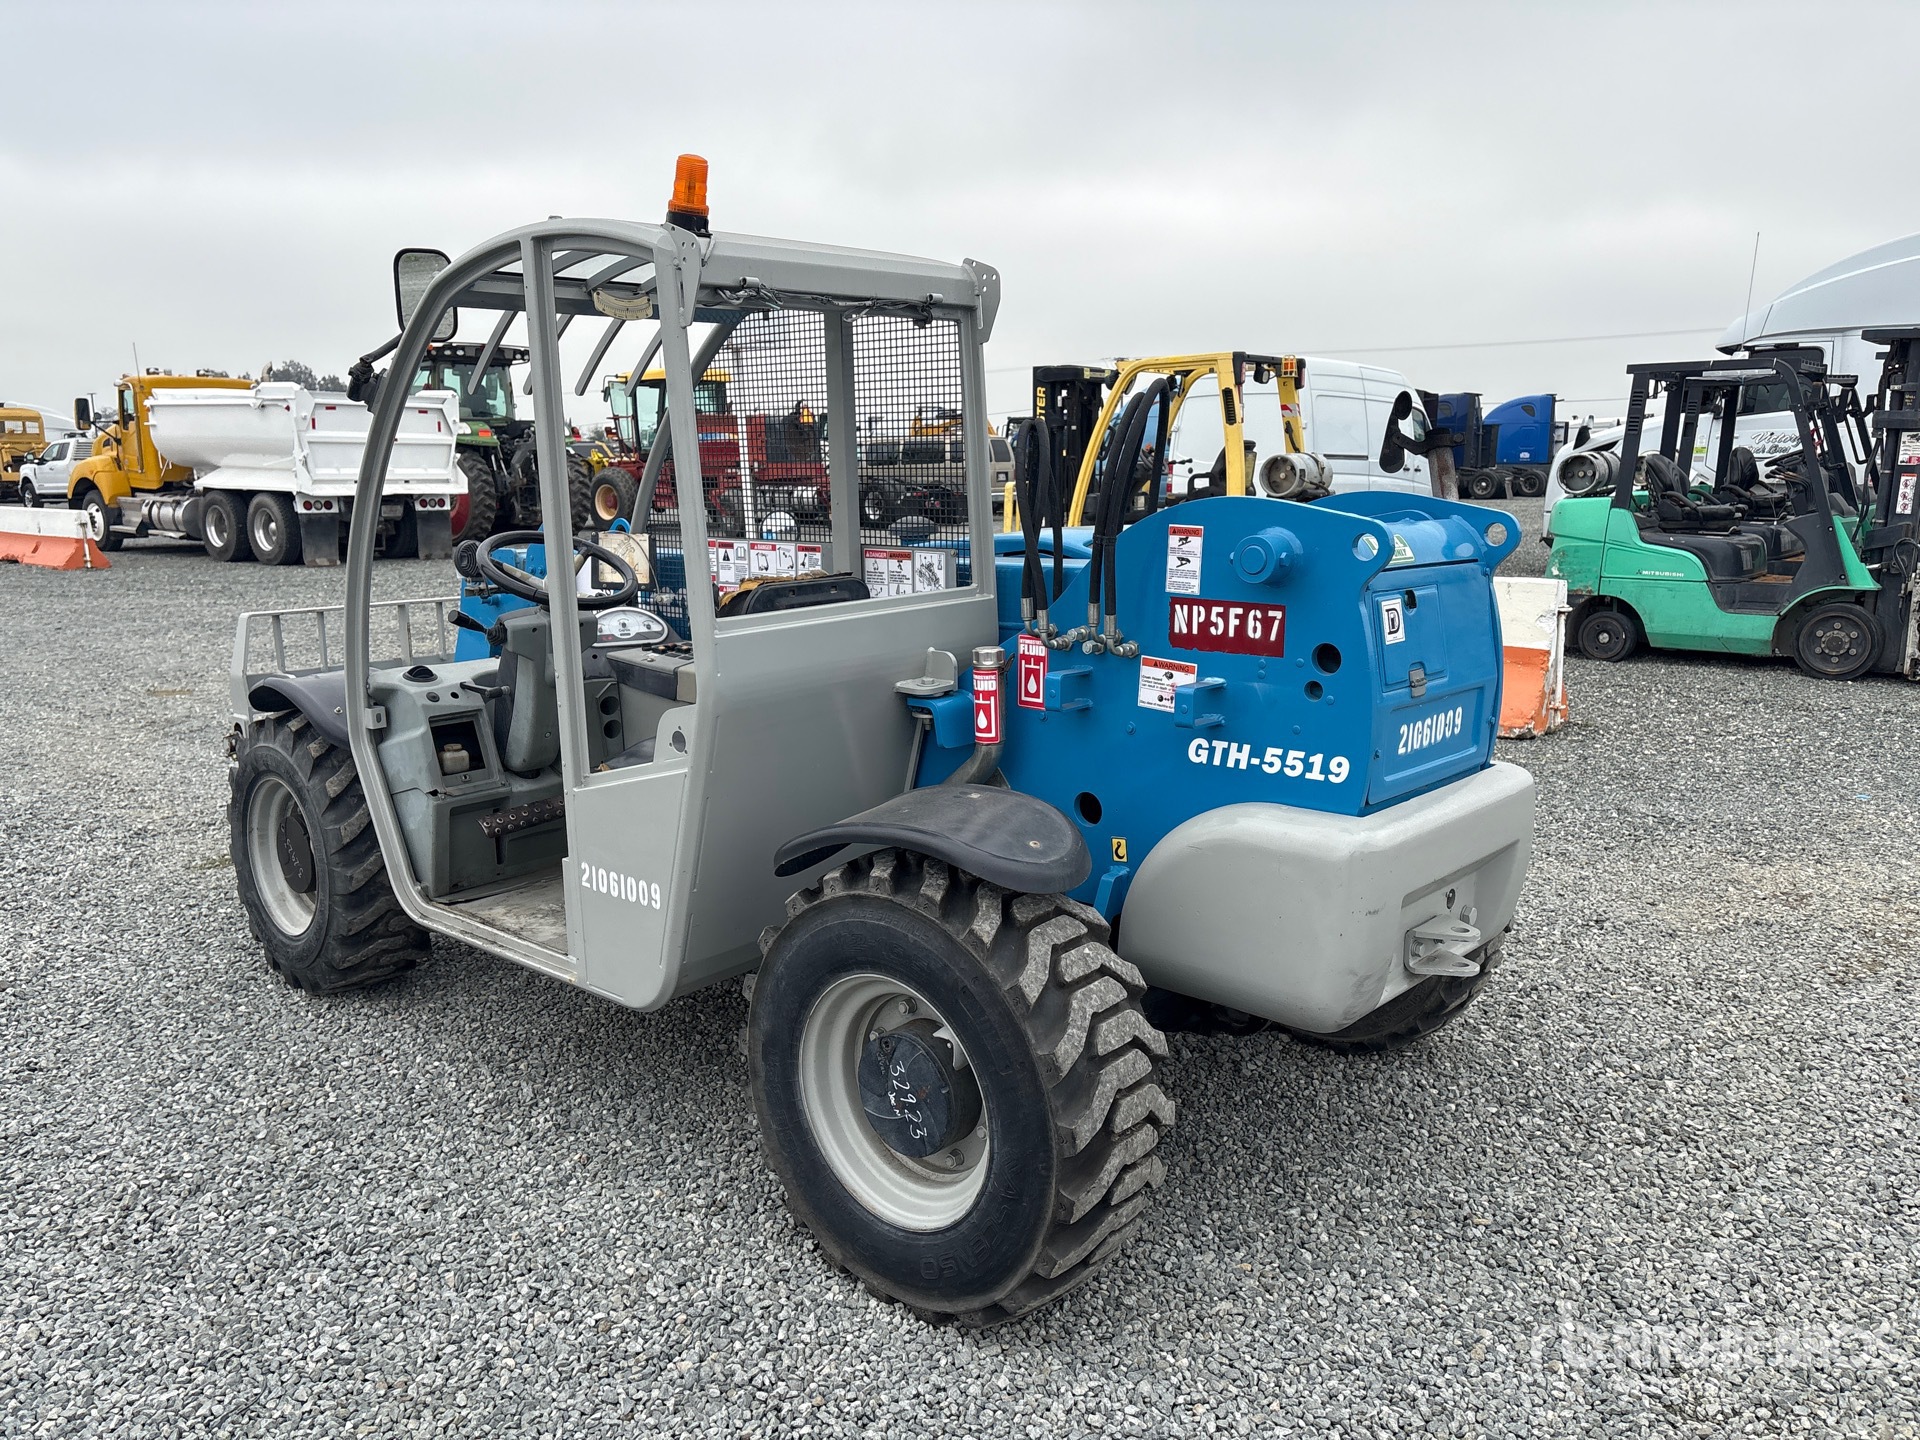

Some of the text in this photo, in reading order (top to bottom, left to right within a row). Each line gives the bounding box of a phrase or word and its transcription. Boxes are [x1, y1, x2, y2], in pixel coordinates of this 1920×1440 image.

[1176, 528, 1200, 536] WARNING
[1174, 604, 1283, 641] NP5F67
[1020, 643, 1045, 656] FLUID
[1159, 660, 1190, 672] WARNING
[1187, 737, 1350, 784] GTH-5519
[581, 862, 661, 910] 21061009
